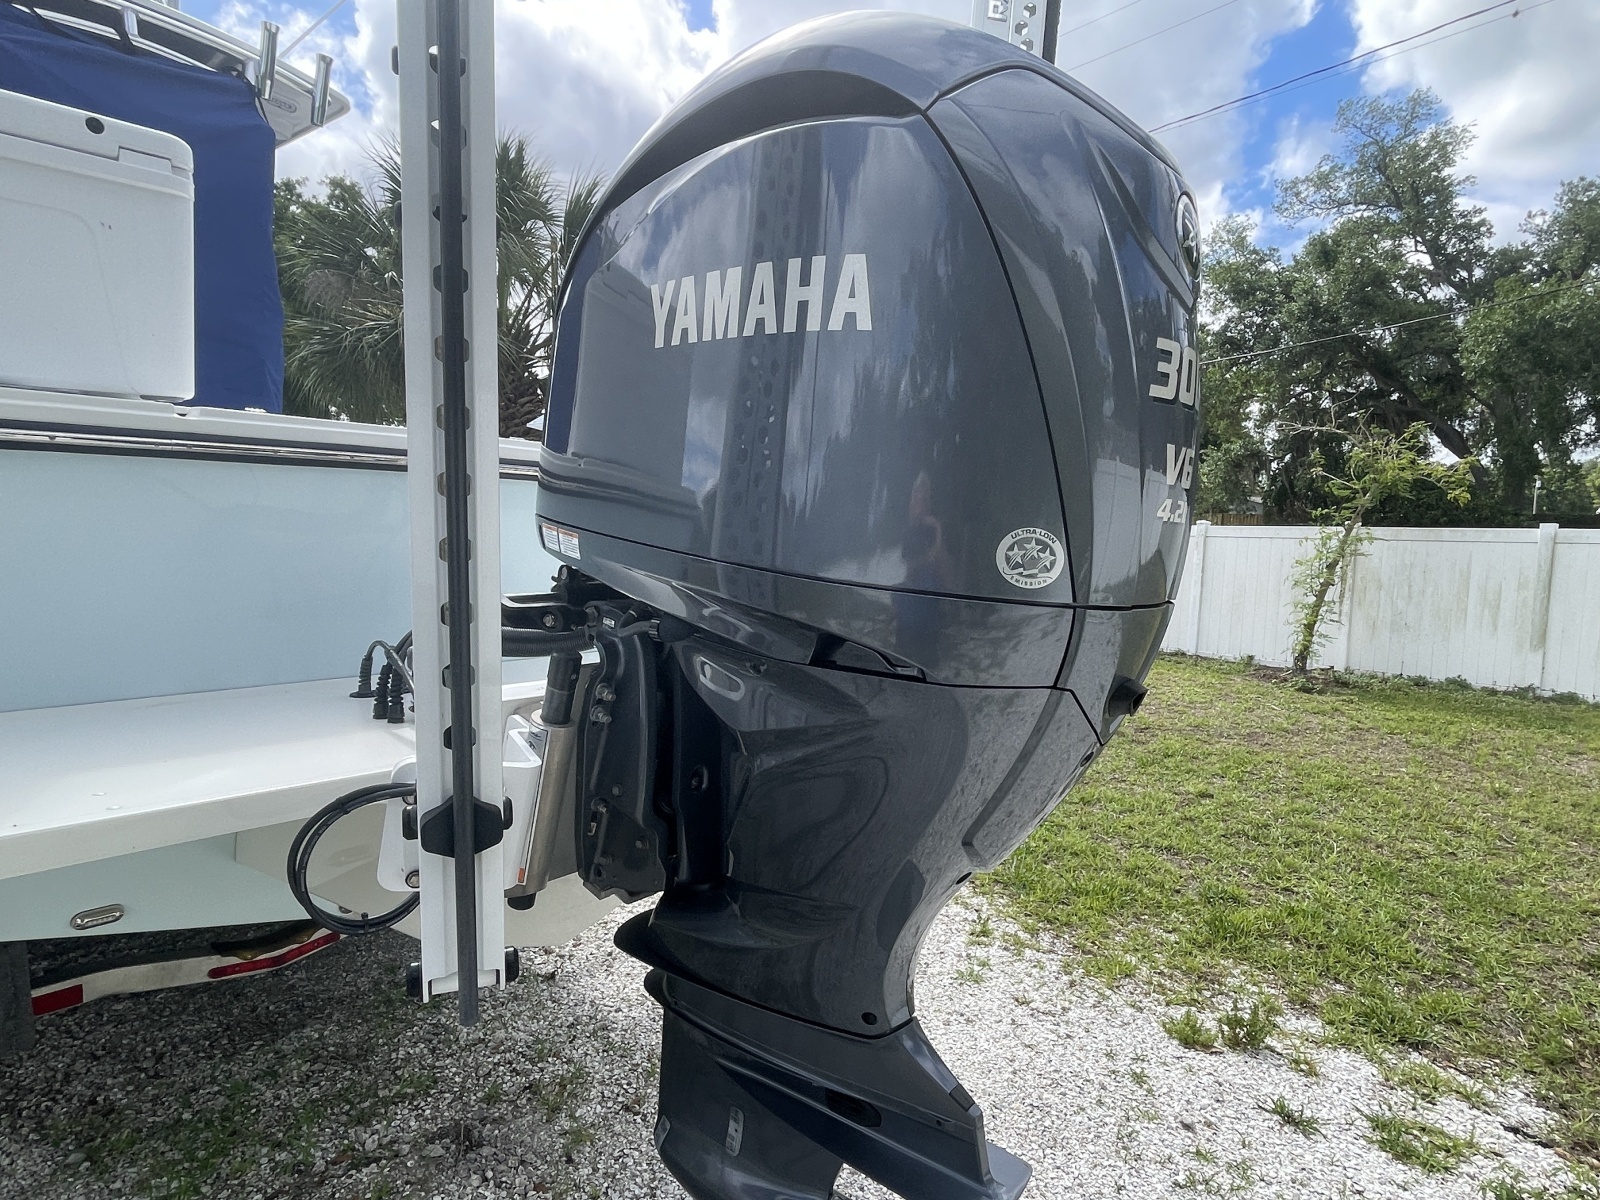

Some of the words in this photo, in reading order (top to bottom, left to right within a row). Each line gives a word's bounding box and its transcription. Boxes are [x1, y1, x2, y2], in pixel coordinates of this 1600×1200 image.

[651, 253, 873, 349] YAMAHA
[1149, 336, 1200, 412] 30
[1166, 443, 1196, 490] V6
[1009, 575, 1048, 587] EMISSION
